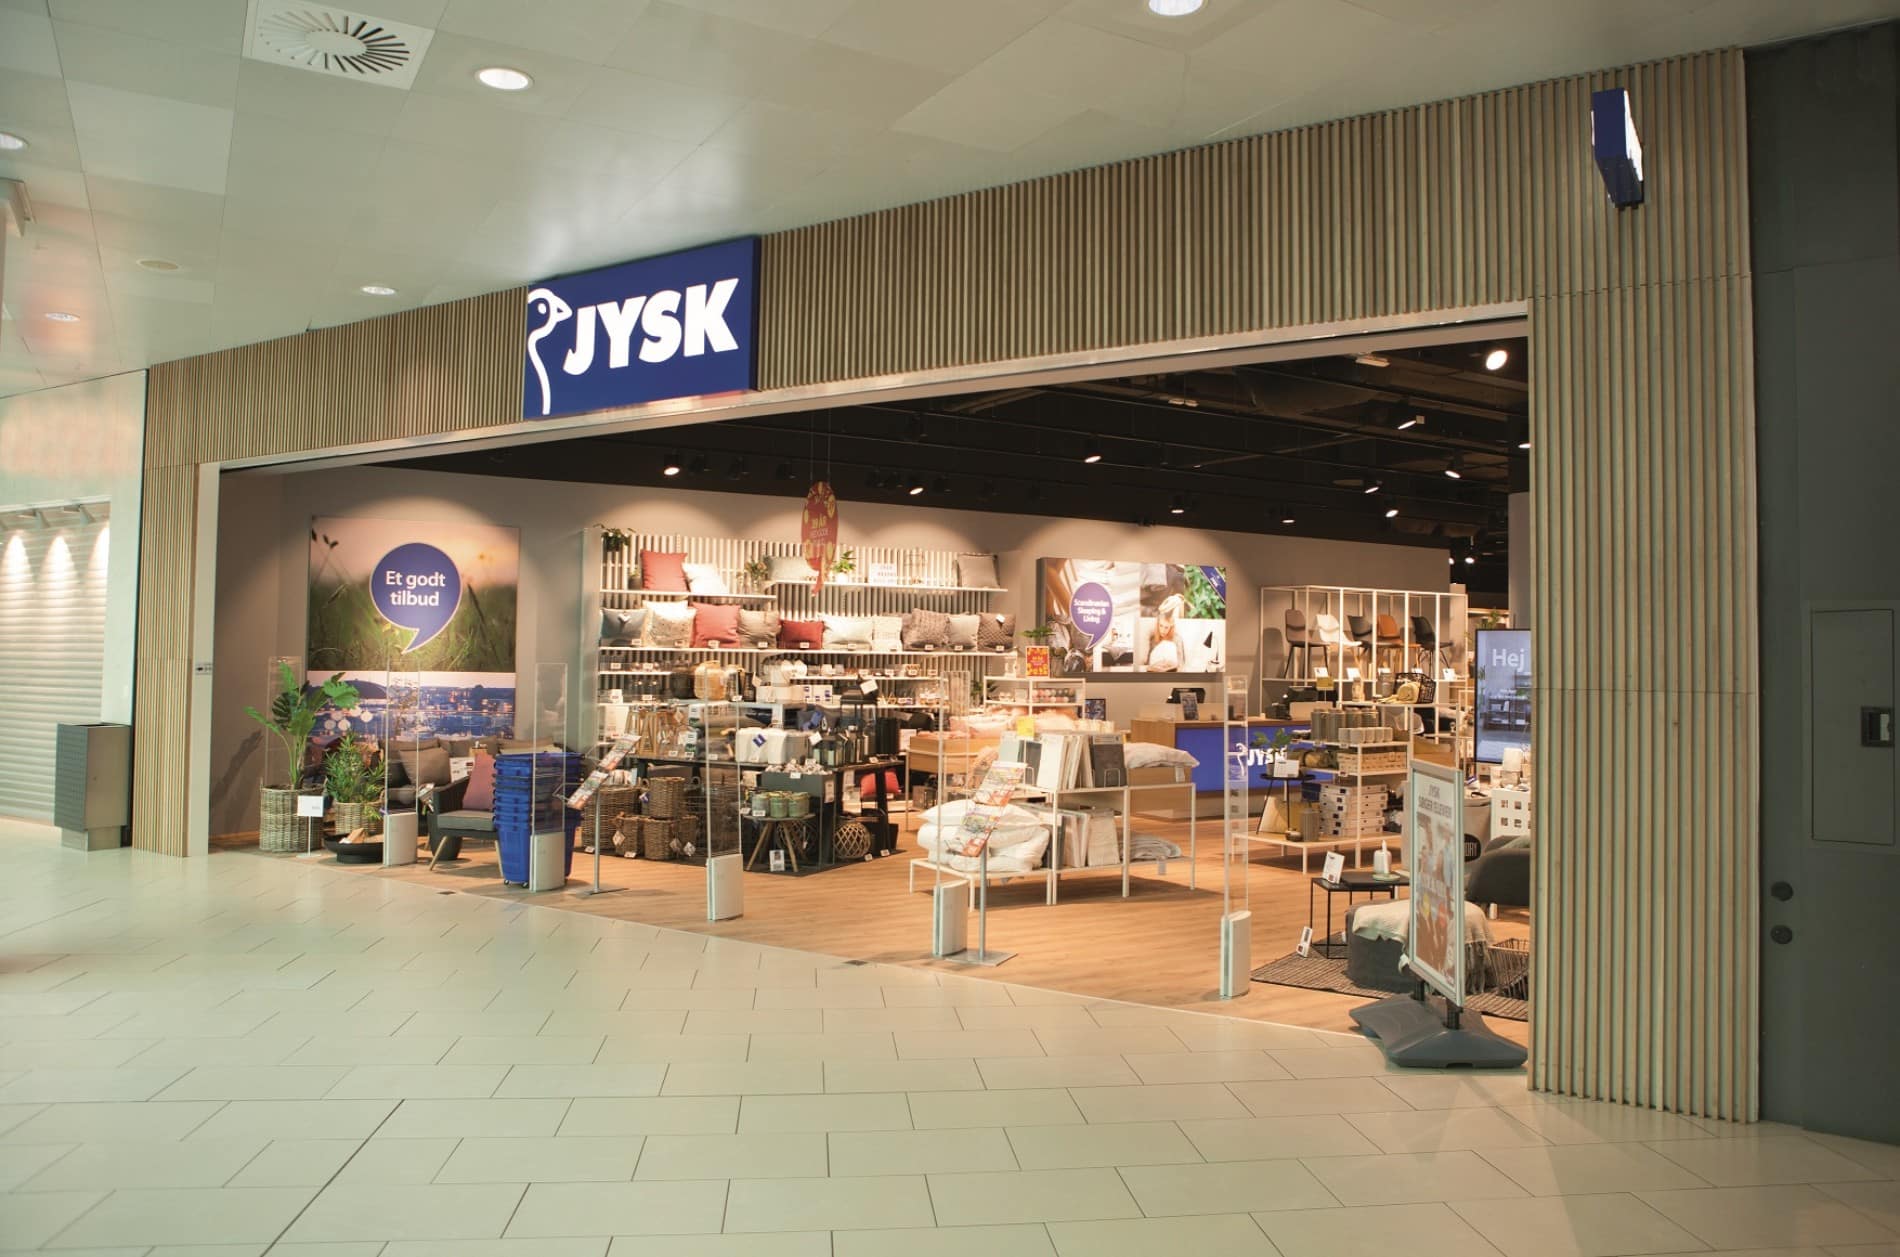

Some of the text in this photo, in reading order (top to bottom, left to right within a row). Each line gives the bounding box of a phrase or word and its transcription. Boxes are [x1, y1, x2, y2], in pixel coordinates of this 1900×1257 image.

[562, 277, 739, 376] JYSK
[385, 570, 446, 589] Et godt
[390, 590, 440, 607] tilbud
[1077, 607, 1100, 616] Sleeping
[1082, 615, 1100, 624] Living
[1492, 648, 1525, 673] Hej
